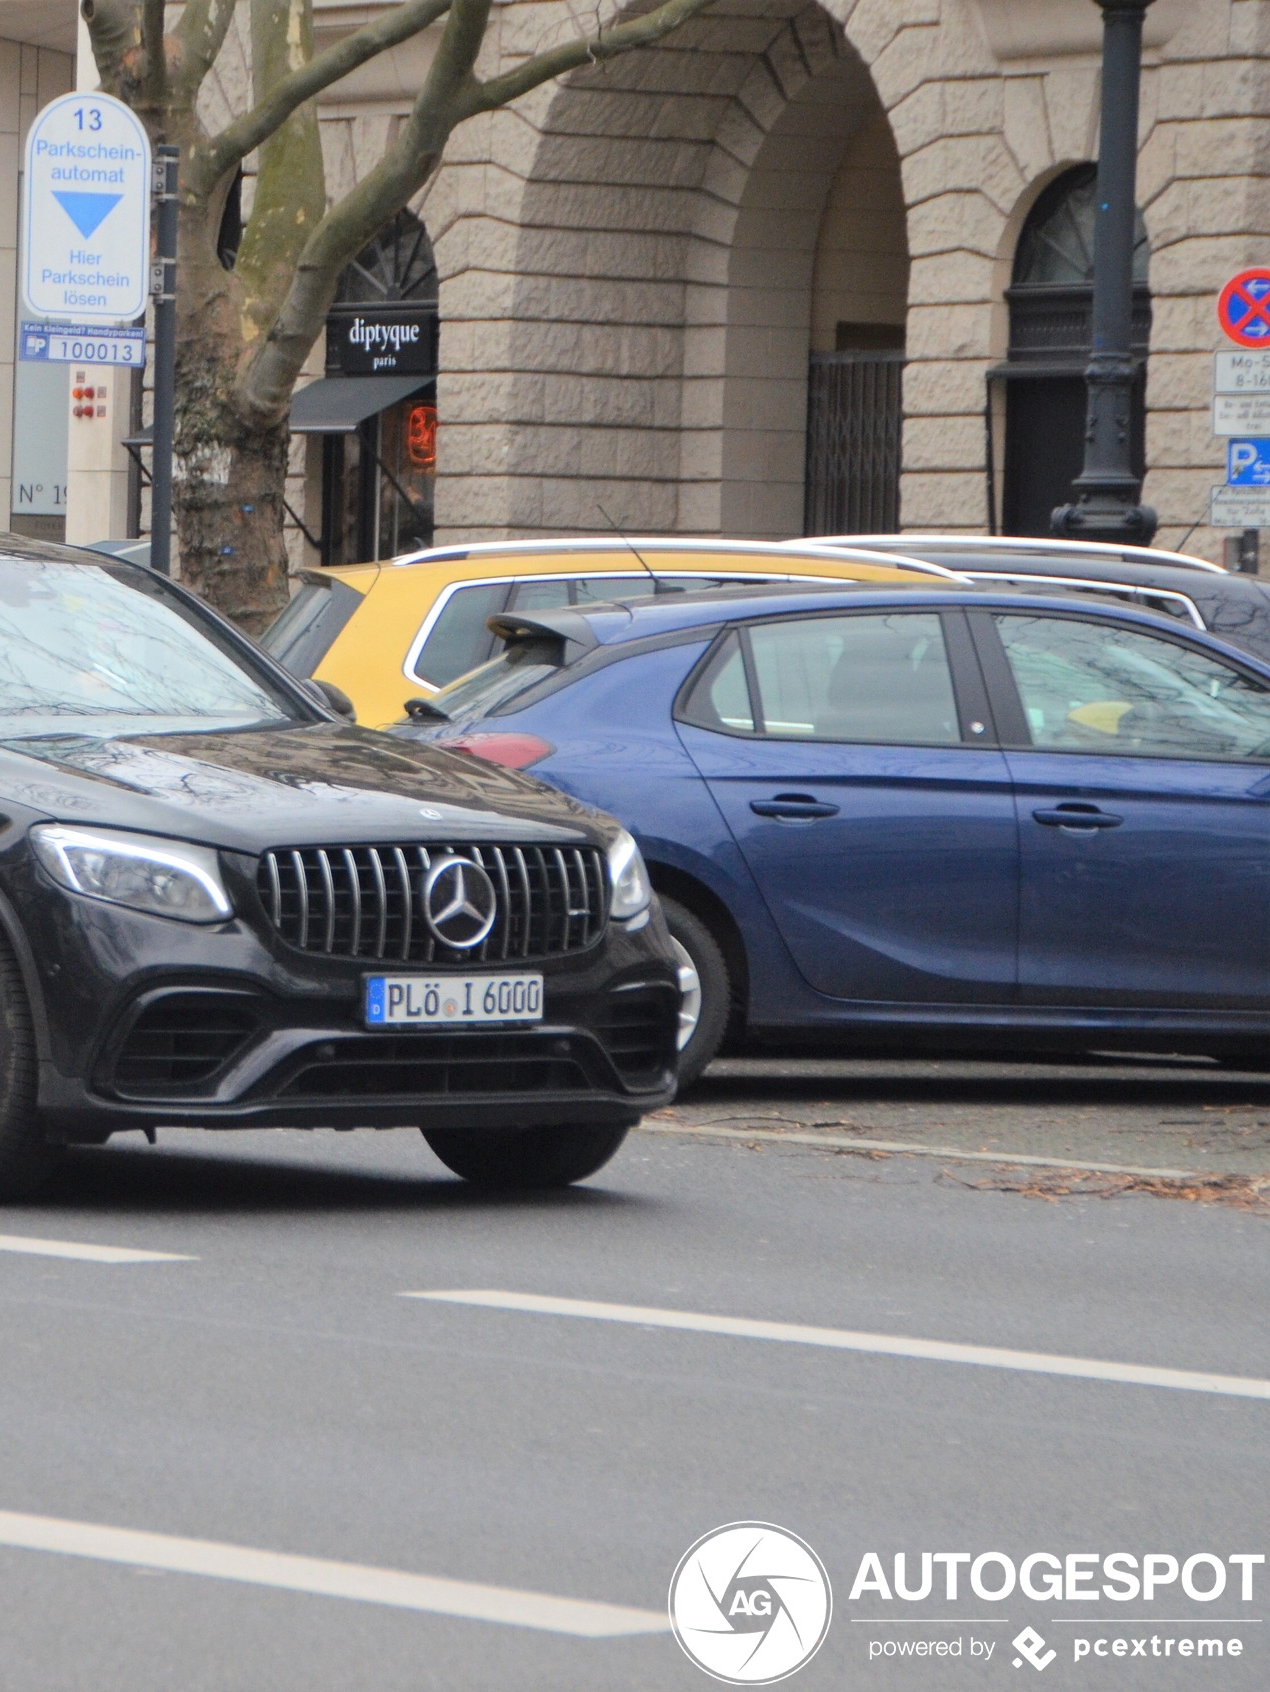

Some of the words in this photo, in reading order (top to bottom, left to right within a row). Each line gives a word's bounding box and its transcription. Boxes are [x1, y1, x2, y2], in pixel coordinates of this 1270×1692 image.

[74, 108, 102, 131] 13
[36, 139, 142, 160] Parkschein-
[50, 165, 125, 182] automat
[69, 249, 103, 265] Hier
[41, 269, 130, 287] Parkschein
[63, 291, 107, 307] lösen
[24, 324, 43, 333] Kein
[43, 326, 86, 337] Kleingeld?
[349, 318, 420, 351] diptyque
[61, 341, 133, 361] 100013
[373, 355, 397, 370] paris
[388, 983, 440, 1017] PLÖ
[462, 982, 473, 1015] I
[483, 980, 540, 1014] 6000
